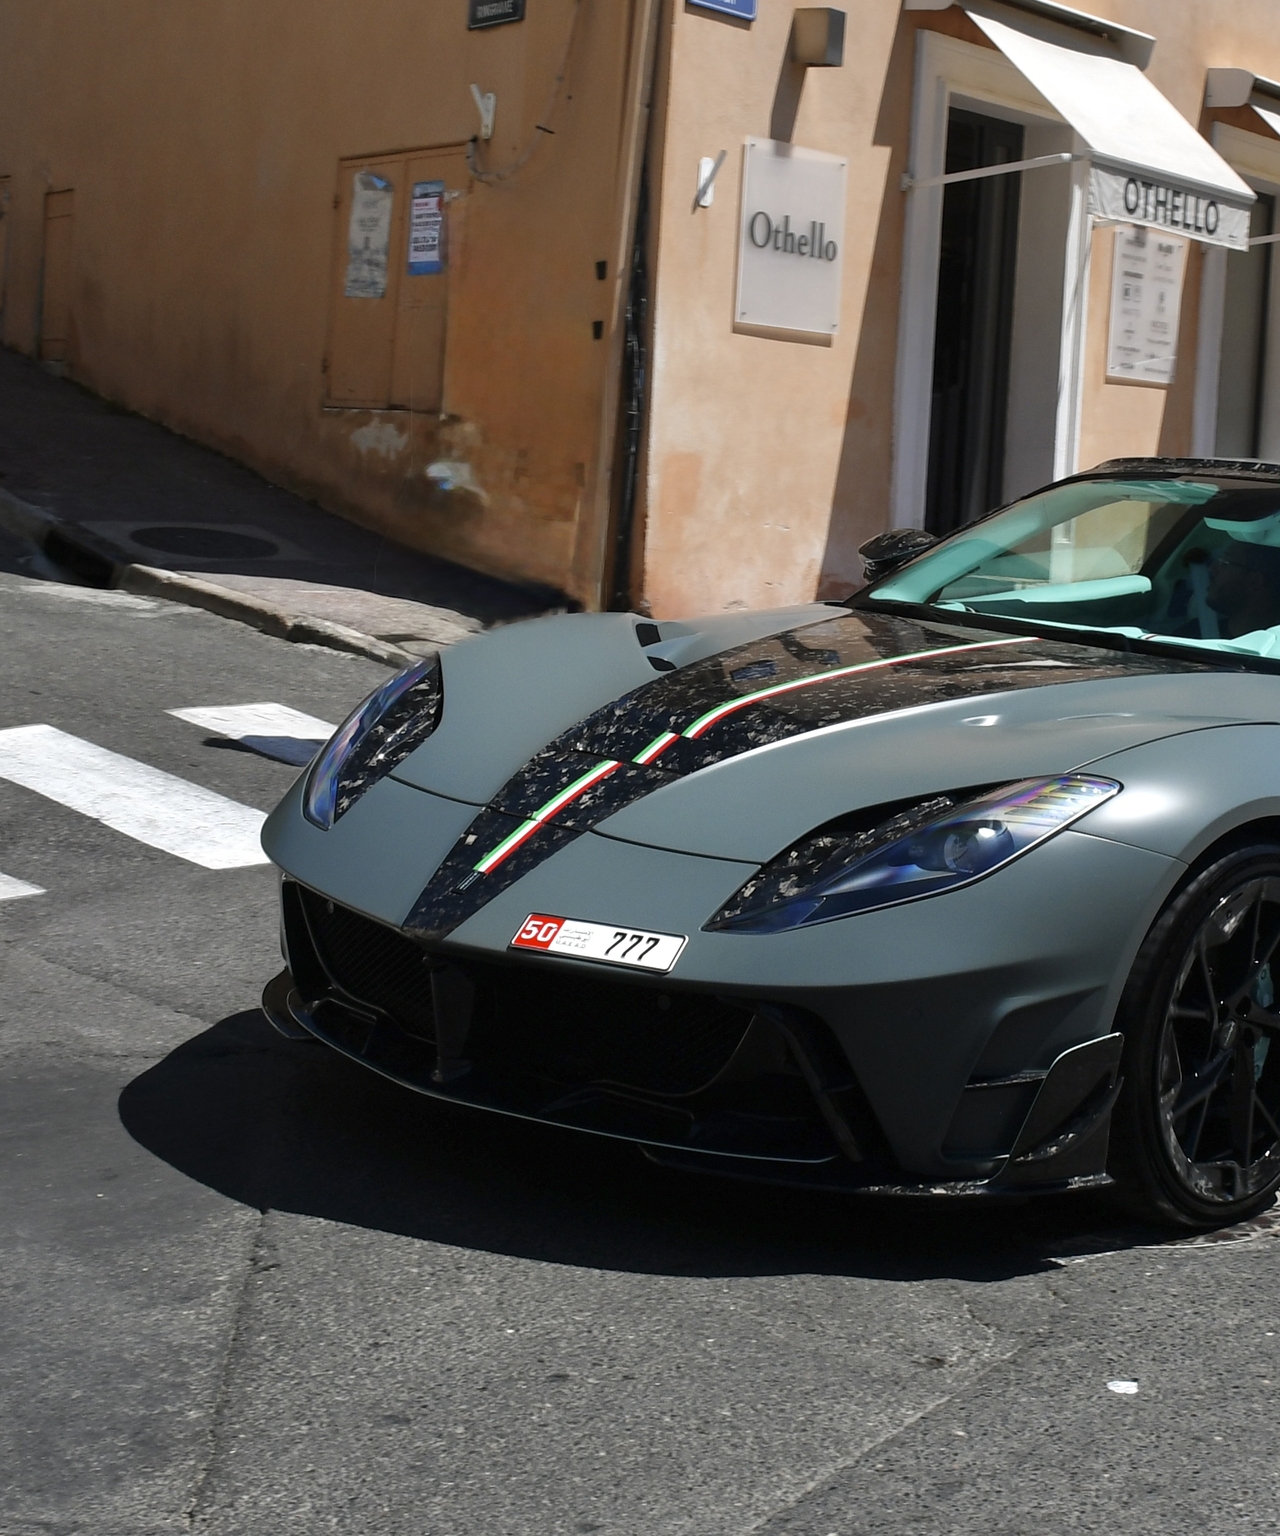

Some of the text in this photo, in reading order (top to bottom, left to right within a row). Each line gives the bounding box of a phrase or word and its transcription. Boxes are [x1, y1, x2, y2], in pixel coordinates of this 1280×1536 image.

[1124, 178, 1218, 235] OTHELLO
[750, 211, 838, 261] Othello
[520, 921, 661, 961] 50 777
